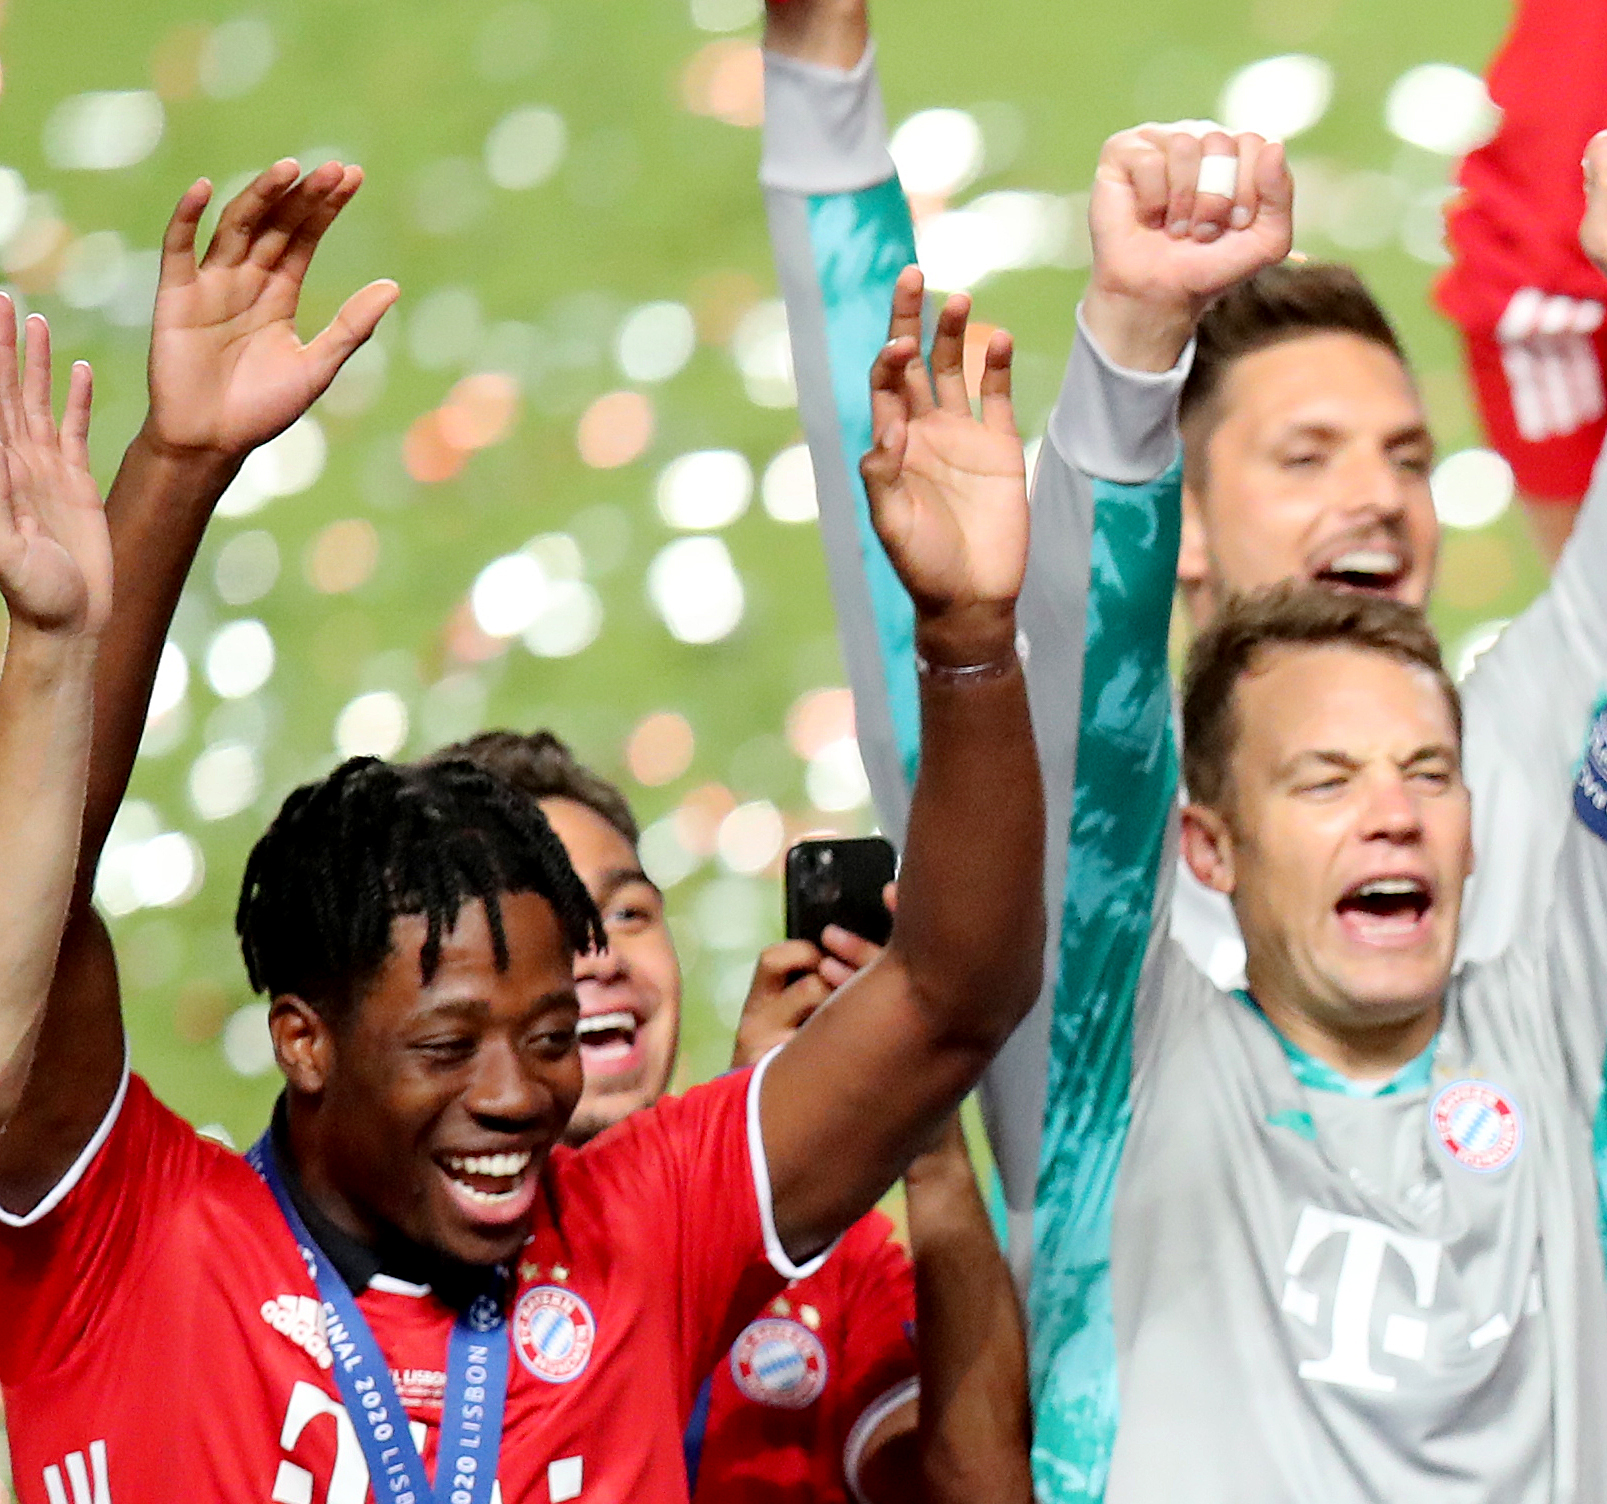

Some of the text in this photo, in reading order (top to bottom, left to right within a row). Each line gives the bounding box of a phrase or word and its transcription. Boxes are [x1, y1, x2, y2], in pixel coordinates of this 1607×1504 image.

[322, 1300, 363, 1374] FINAL
[353, 1375, 394, 1442] 2020
[459, 1345, 490, 1450] LISBON
